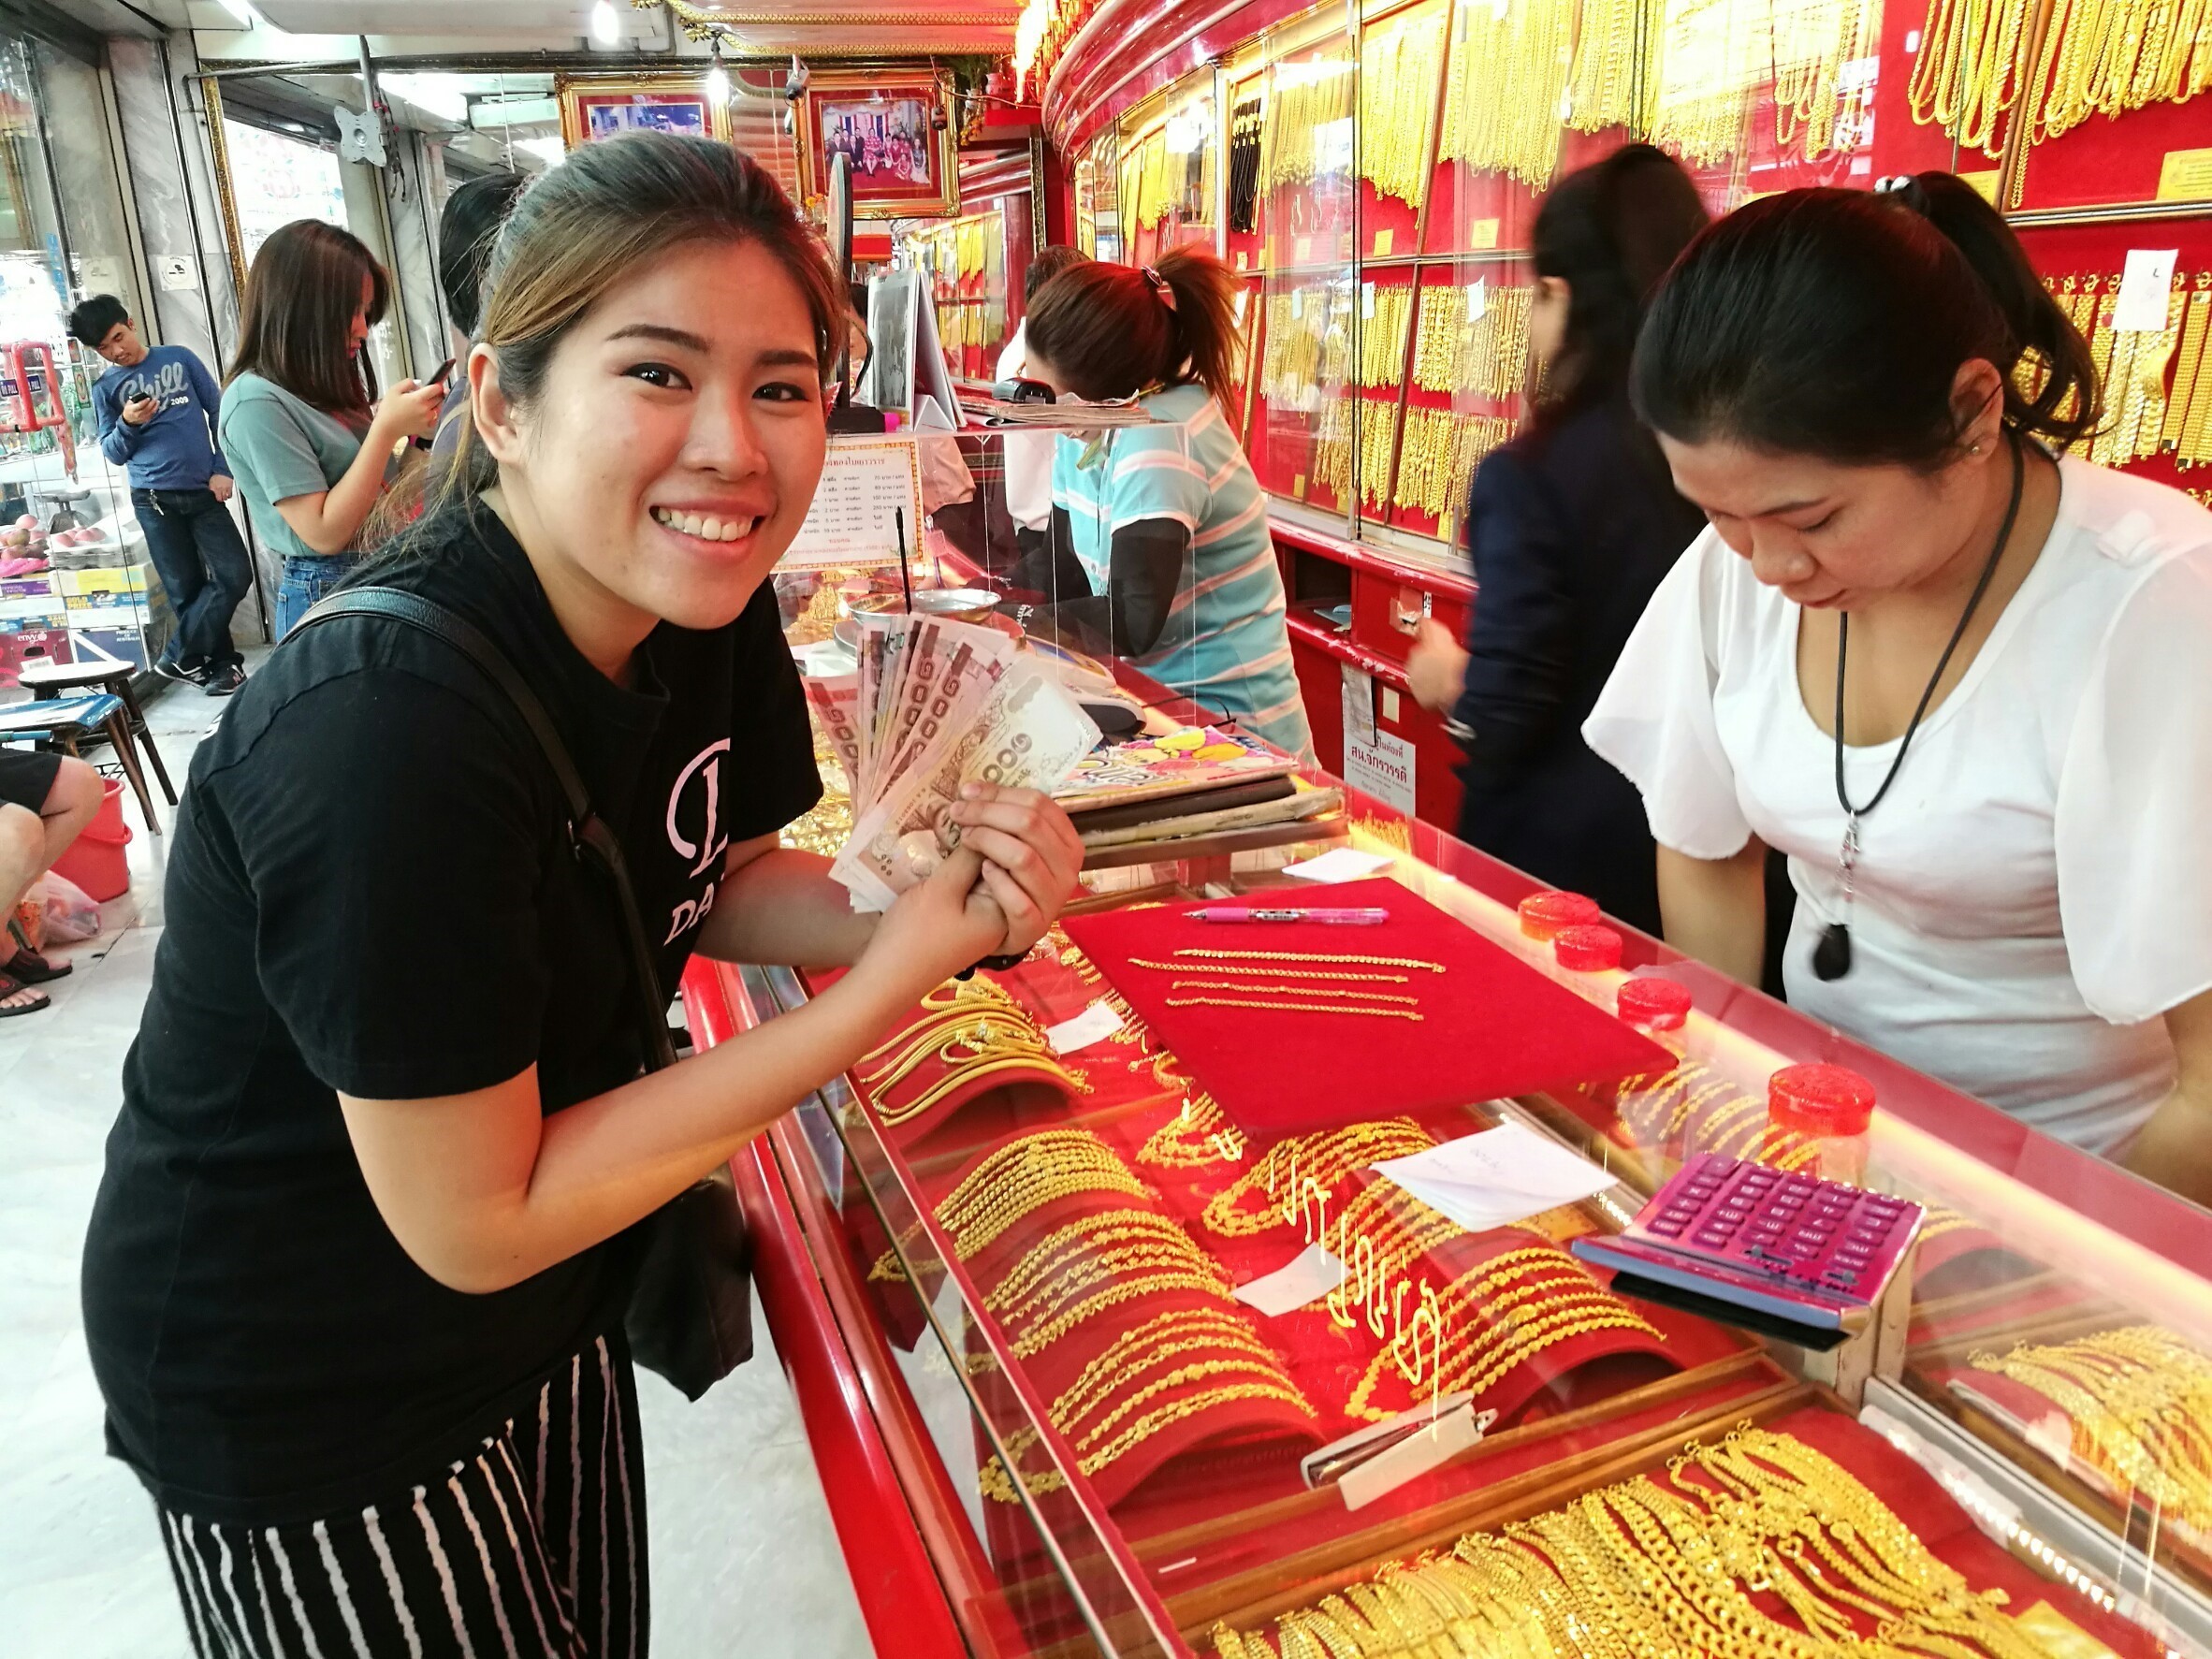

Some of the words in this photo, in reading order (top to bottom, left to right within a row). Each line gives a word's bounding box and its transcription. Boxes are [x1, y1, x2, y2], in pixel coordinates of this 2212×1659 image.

[119, 361, 189, 408] Chill
[170, 396, 189, 405] 2009
[663, 881, 716, 947] DA
